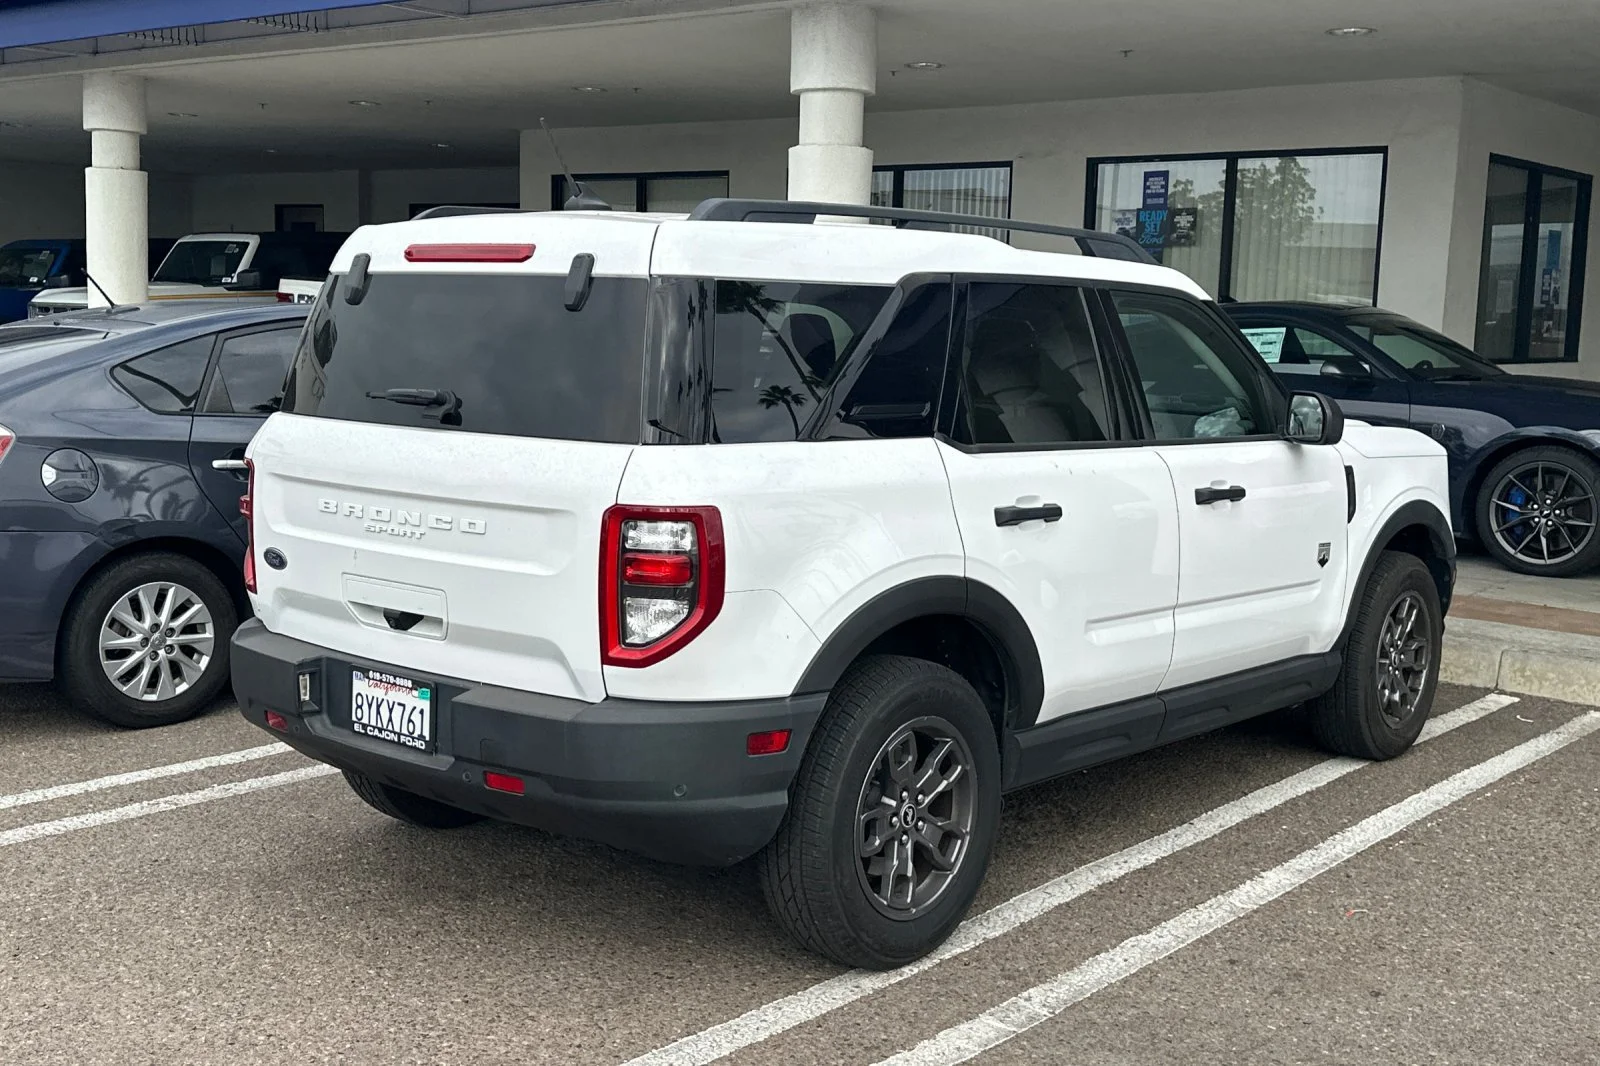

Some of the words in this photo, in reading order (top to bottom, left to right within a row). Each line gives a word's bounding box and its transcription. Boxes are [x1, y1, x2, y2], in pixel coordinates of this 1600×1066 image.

[1139, 210, 1168, 222] READY
[1145, 221, 1161, 233] SET
[1139, 232, 1164, 244] Ford
[318, 498, 487, 535] BRONCO
[364, 523, 426, 540] SPORT
[354, 691, 427, 741] 8YKX761
[354, 723, 366, 733] EL
[367, 726, 399, 742] CAJON
[400, 735, 426, 750] FORD
